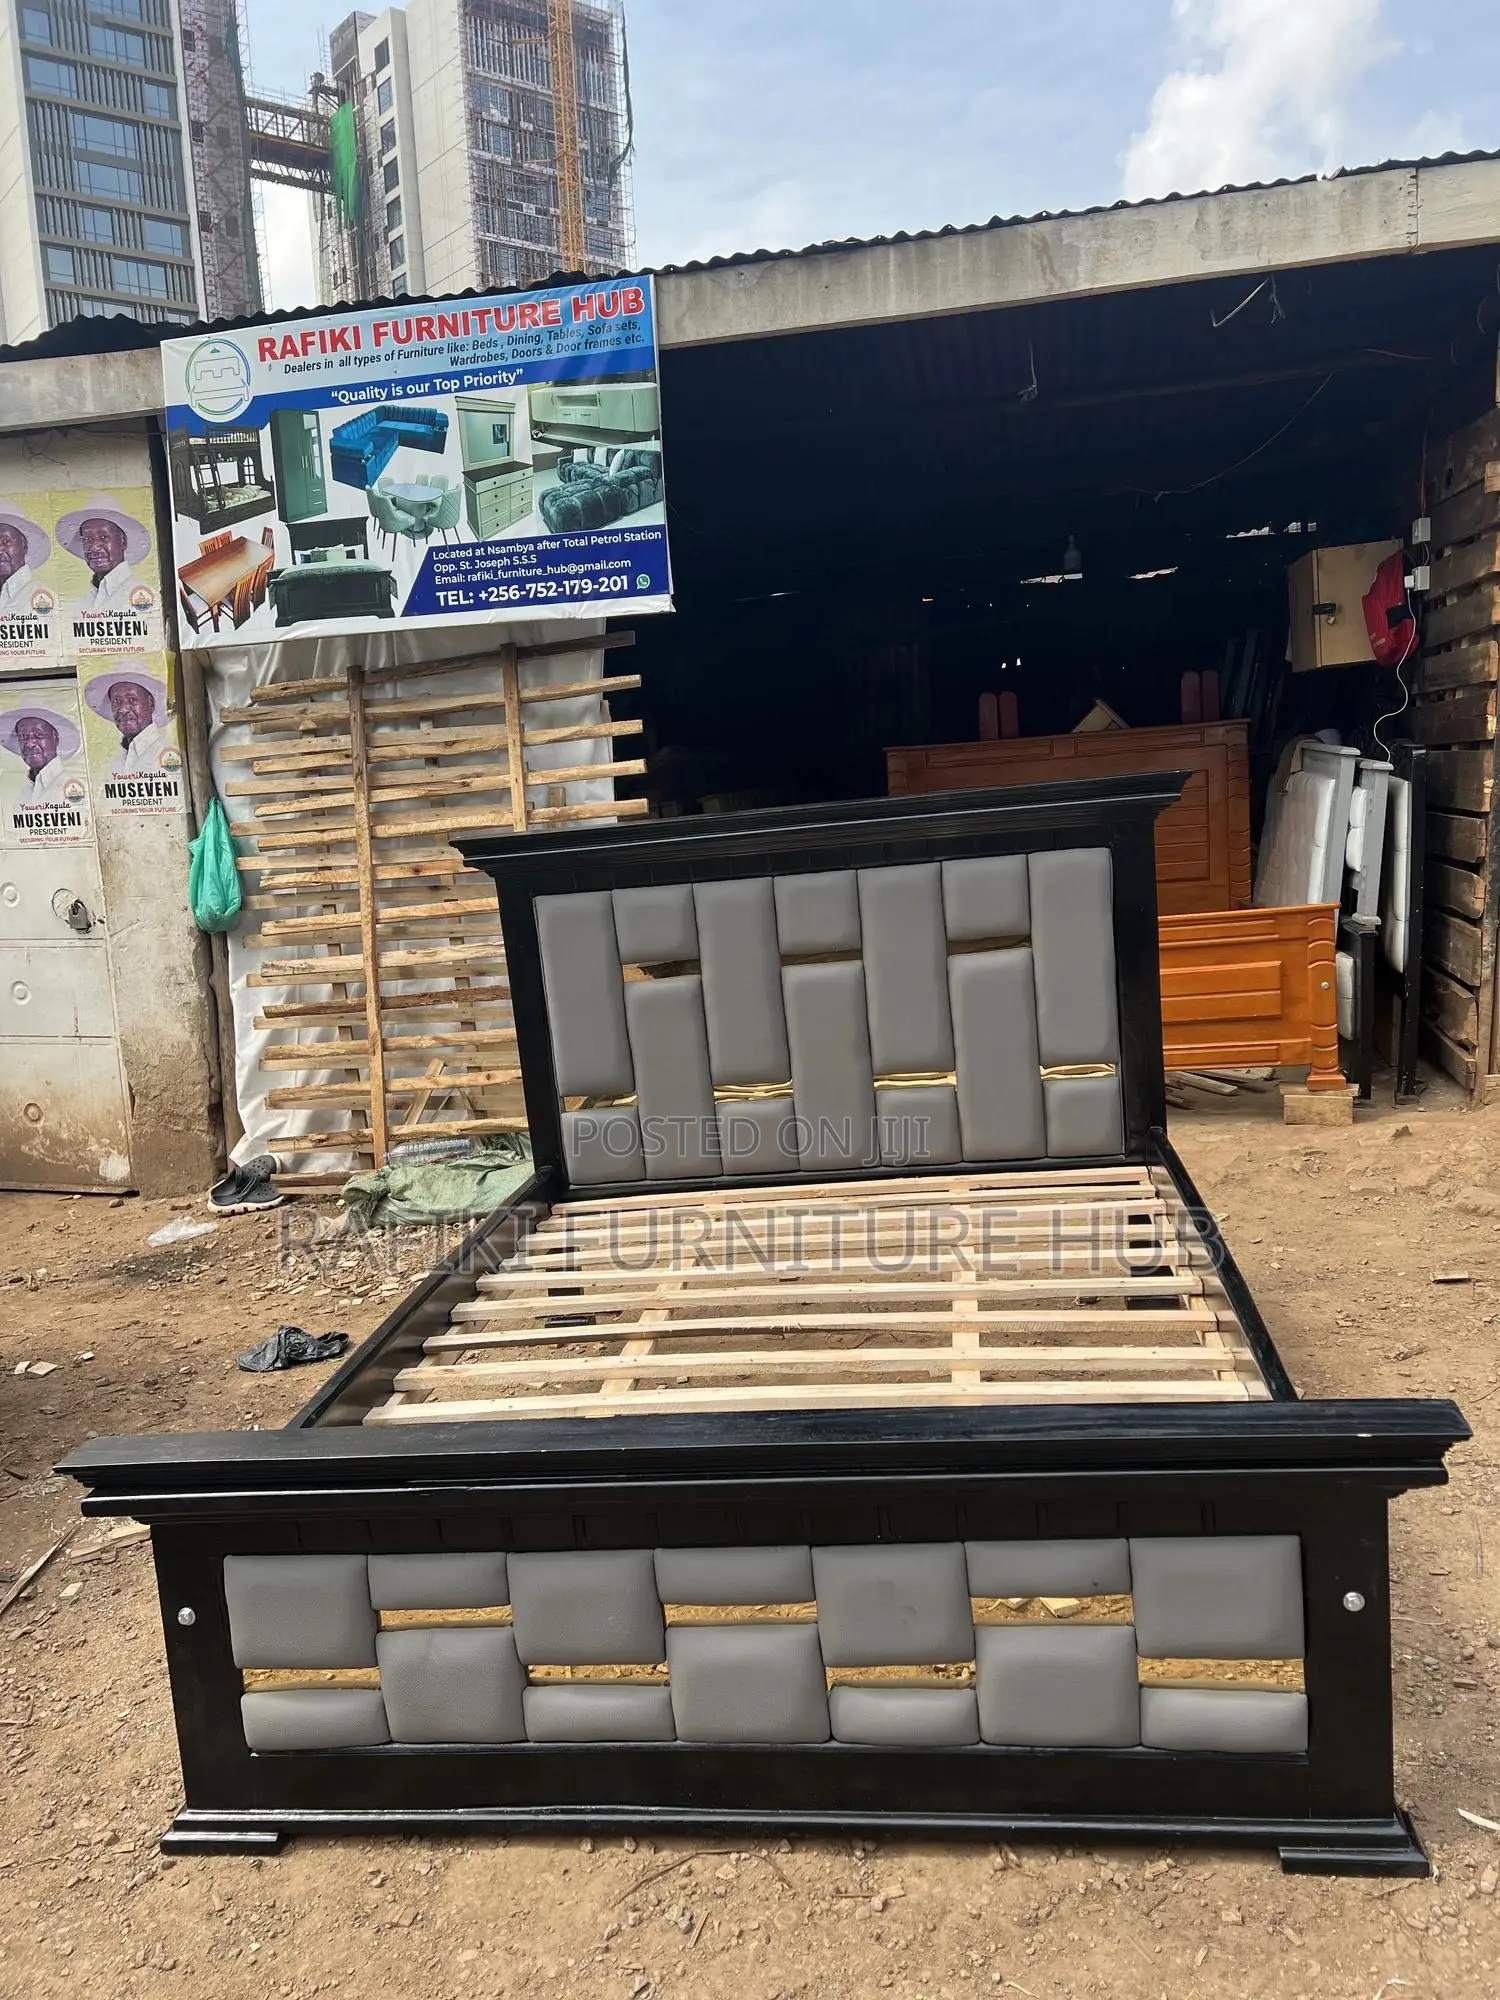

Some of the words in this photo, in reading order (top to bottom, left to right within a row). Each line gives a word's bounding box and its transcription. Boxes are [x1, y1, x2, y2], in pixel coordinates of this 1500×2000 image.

[257, 325, 362, 363] RAFIKI
[372, 299, 562, 349] FURNITURE
[571, 286, 645, 324] HUB
[284, 360, 322, 374] Dealers
[324, 358, 334, 369] in
[339, 356, 350, 367] all
[353, 353, 381, 367] types
[384, 350, 395, 362] of
[398, 346, 443, 360] Furniture
[447, 341, 470, 354] like:
[472, 338, 498, 351] Beds
[507, 332, 544, 347] Dining,
[547, 329, 584, 342] Tables,
[587, 324, 612, 336] Sofa
[614, 320, 641, 333] sets,
[449, 350, 508, 367] Wardrobes,
[511, 345, 542, 359] Doors
[545, 344, 553, 355] &
[557, 340, 581, 353] Door
[584, 336, 621, 349] frames
[625, 332, 644, 345] etc.
[331, 386, 388, 405] “Quality
[391, 383, 403, 396] is
[406, 382, 430, 395] our
[433, 377, 460, 392] Top
[463, 368, 523, 387] Priority”
[433, 548, 473, 560] Located
[475, 547, 485, 557] at
[487, 541, 534, 555] Nsambya
[537, 539, 560, 550] after
[563, 536, 588, 548] Total
[591, 533, 622, 545] Petrol
[624, 529, 662, 542] Station
[433, 562, 458, 574] Opp.
[459, 560, 473, 570] St.
[474, 556, 511, 569] Joseph
[512, 554, 537, 565] S.S.S
[435, 574, 466, 585] Email:
[467, 558, 632, 583] rafiki_furniture_hub@gmail.com
[436, 590, 475, 607] TEL:
[478, 575, 629, 602] +256-752-179-201
[0, 623, 49, 640] SEVENI
[73, 620, 148, 637] MUSEVENI
[90, 638, 132, 646] PRESIDENT
[105, 781, 179, 798] MUSEVENI
[122, 798, 163, 807] PRESIDENT
[13, 812, 81, 828] MUSEVENI
